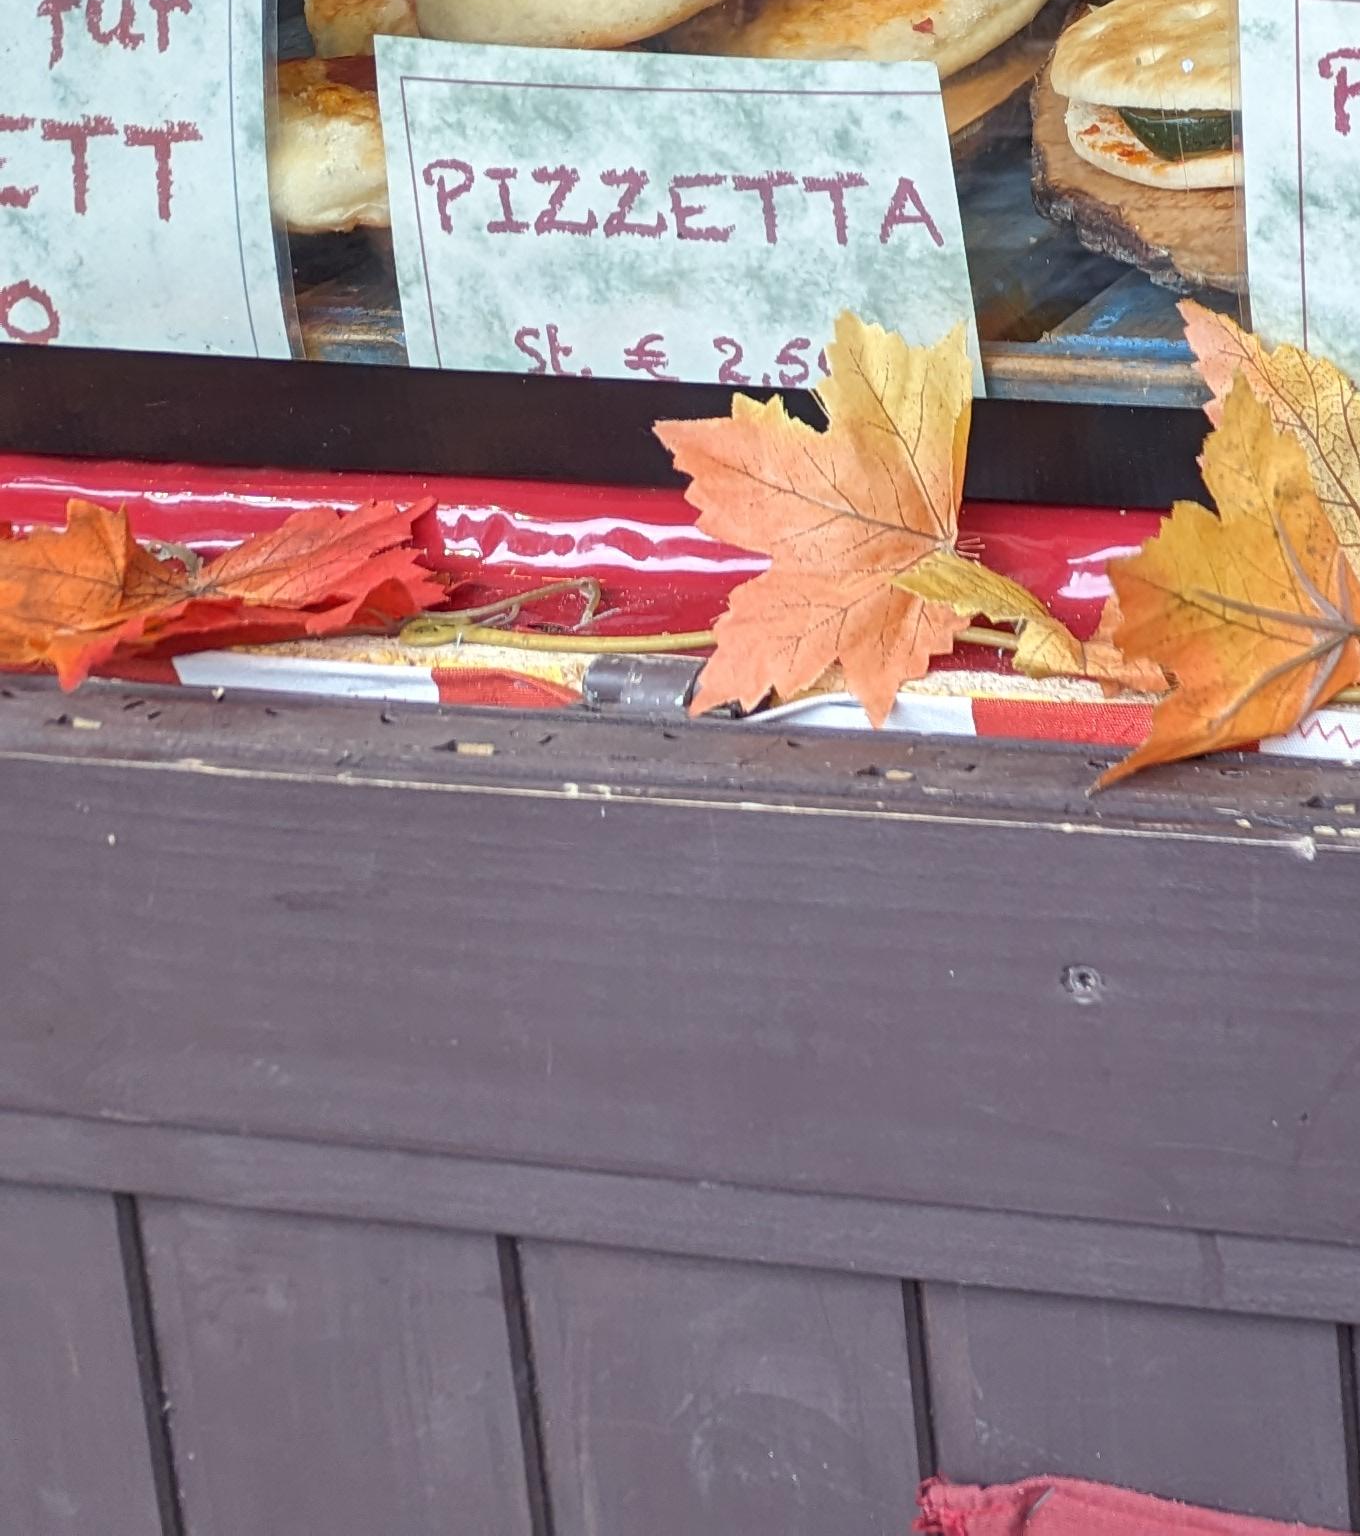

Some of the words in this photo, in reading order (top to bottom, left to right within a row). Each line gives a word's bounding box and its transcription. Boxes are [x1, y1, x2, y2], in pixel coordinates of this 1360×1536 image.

[422, 157, 945, 247] PIZZETTA
[513, 323, 593, 380] St.
[624, 332, 680, 382] €
